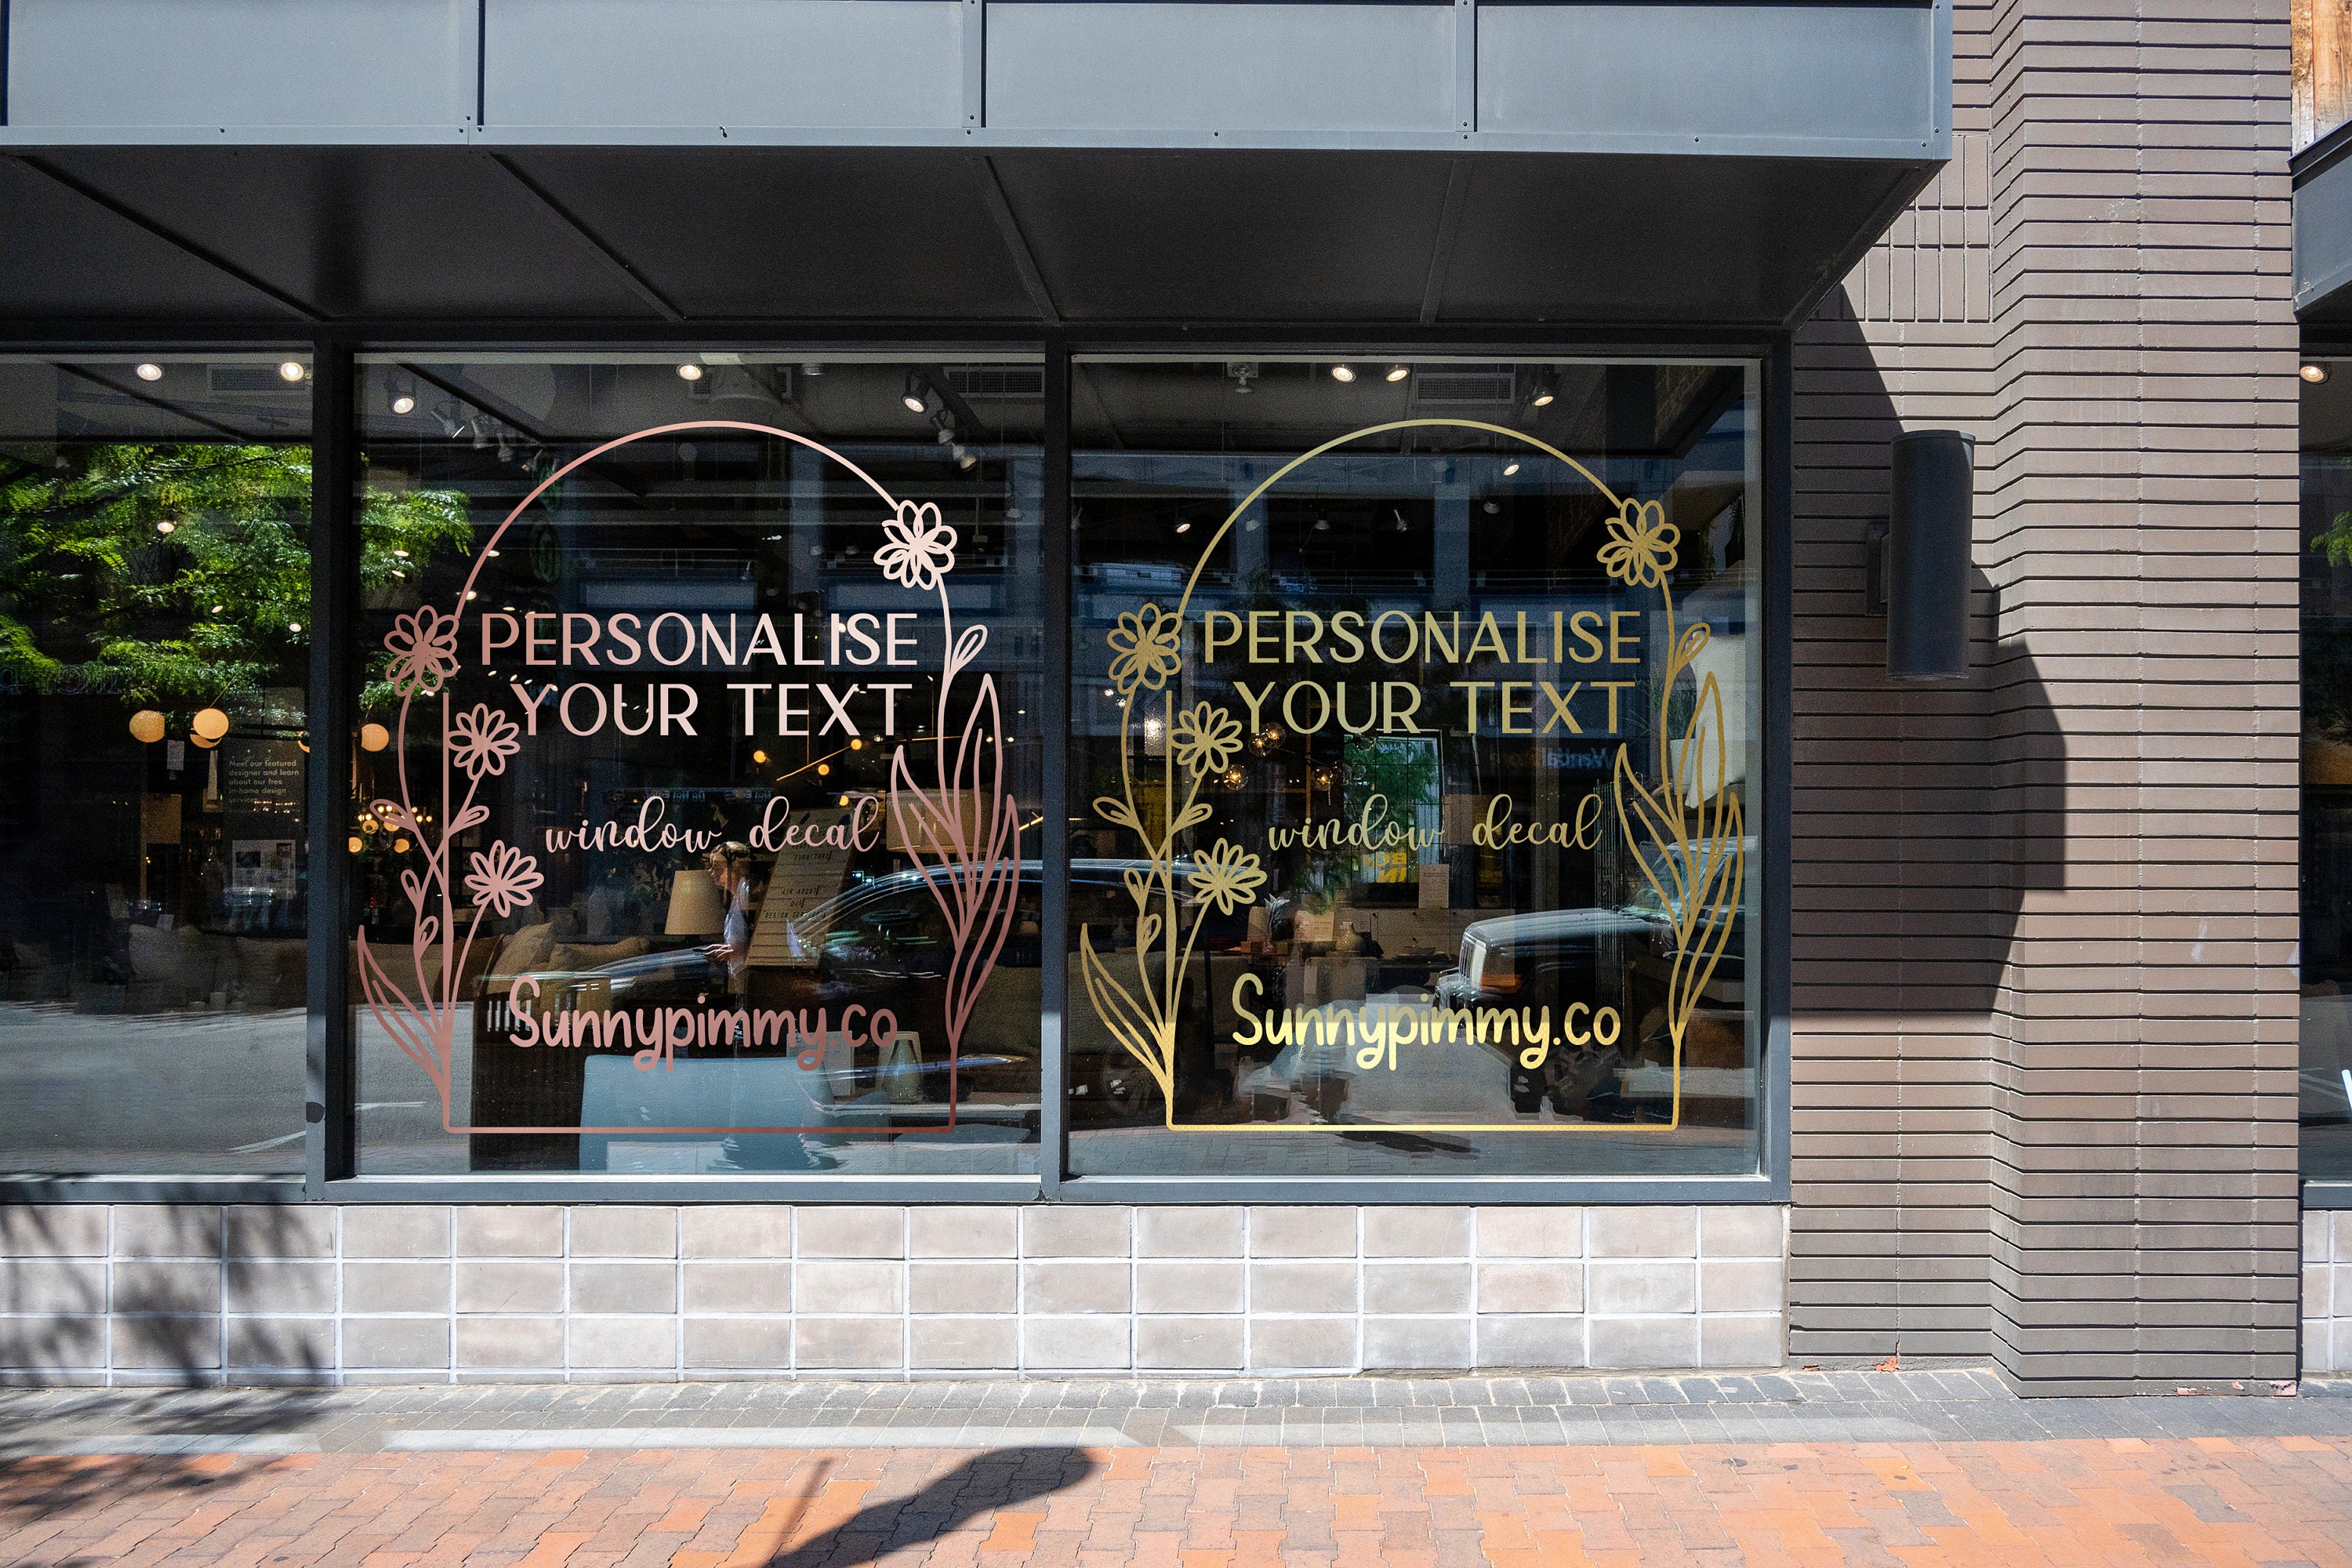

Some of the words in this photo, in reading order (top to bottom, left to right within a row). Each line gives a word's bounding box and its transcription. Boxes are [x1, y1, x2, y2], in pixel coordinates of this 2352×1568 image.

[481, 612, 918, 666] PERSONALISE
[1205, 610, 1641, 663] PERSONALISE
[509, 683, 698, 735] YOUR
[727, 683, 912, 736] TEXT
[1232, 681, 1421, 734] YOUR
[1450, 682, 1635, 734] TEXT
[261, 787, 286, 796] design
[546, 797, 722, 852] window
[750, 796, 879, 851] decal
[1269, 793, 1443, 850] window
[1472, 794, 1602, 850] decal
[509, 977, 898, 1072] Sunnypimmy.co
[1232, 974, 1621, 1069] Sunnypimmy.co
